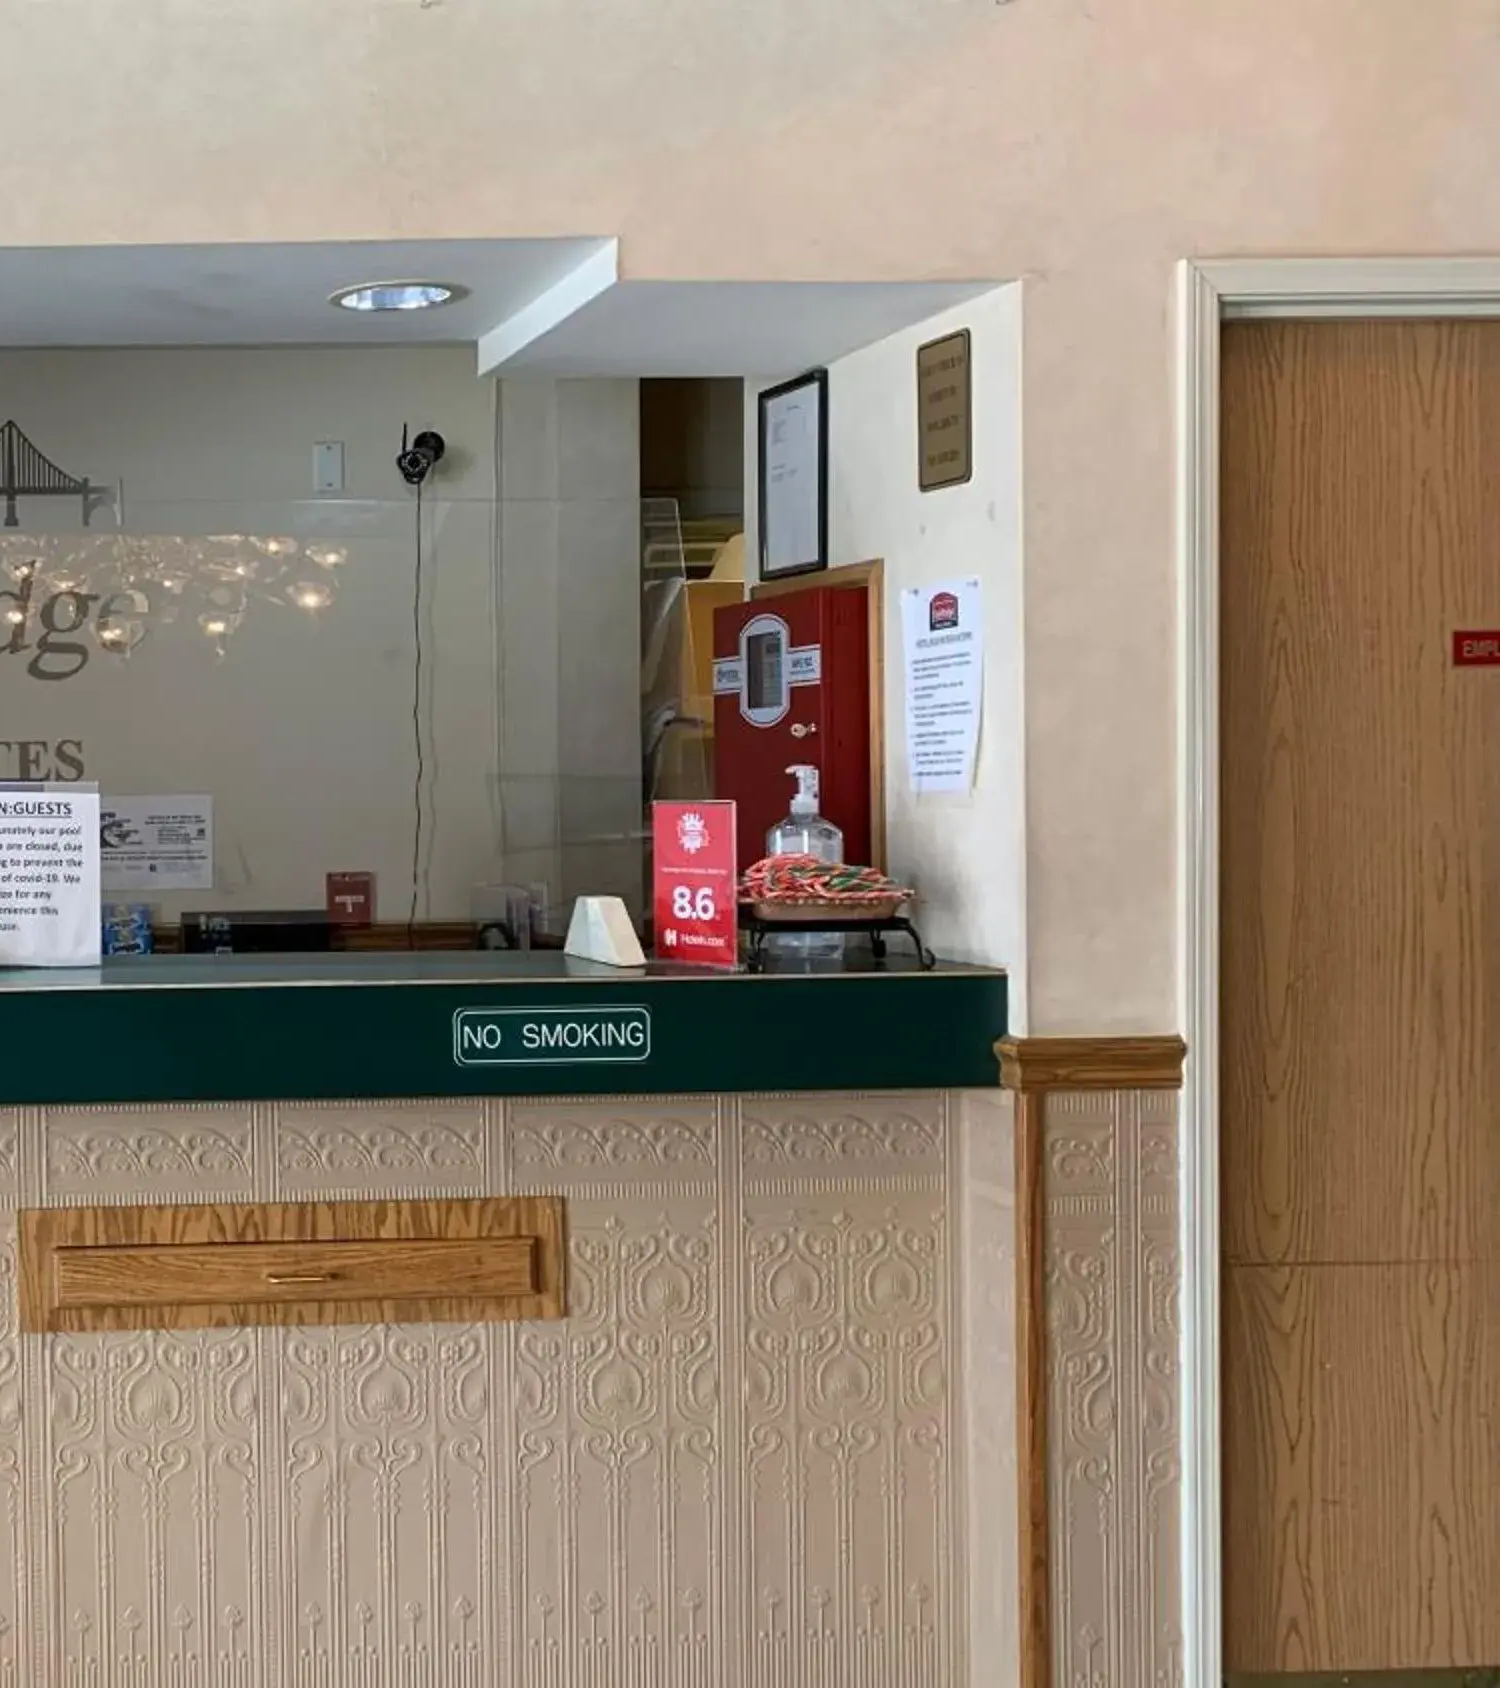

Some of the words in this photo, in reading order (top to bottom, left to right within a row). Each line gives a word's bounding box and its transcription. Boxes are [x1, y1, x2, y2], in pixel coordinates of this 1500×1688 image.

[10, 858, 21, 866] to
[23, 859, 63, 868] prevent
[65, 857, 83, 866] the
[1, 873, 13, 882] of
[63, 874, 82, 883] We
[16, 889, 30, 898] for
[32, 891, 52, 900] any
[672, 885, 715, 921] 8.6
[463, 1024, 501, 1049] NO
[523, 1022, 644, 1048] SMOKING
